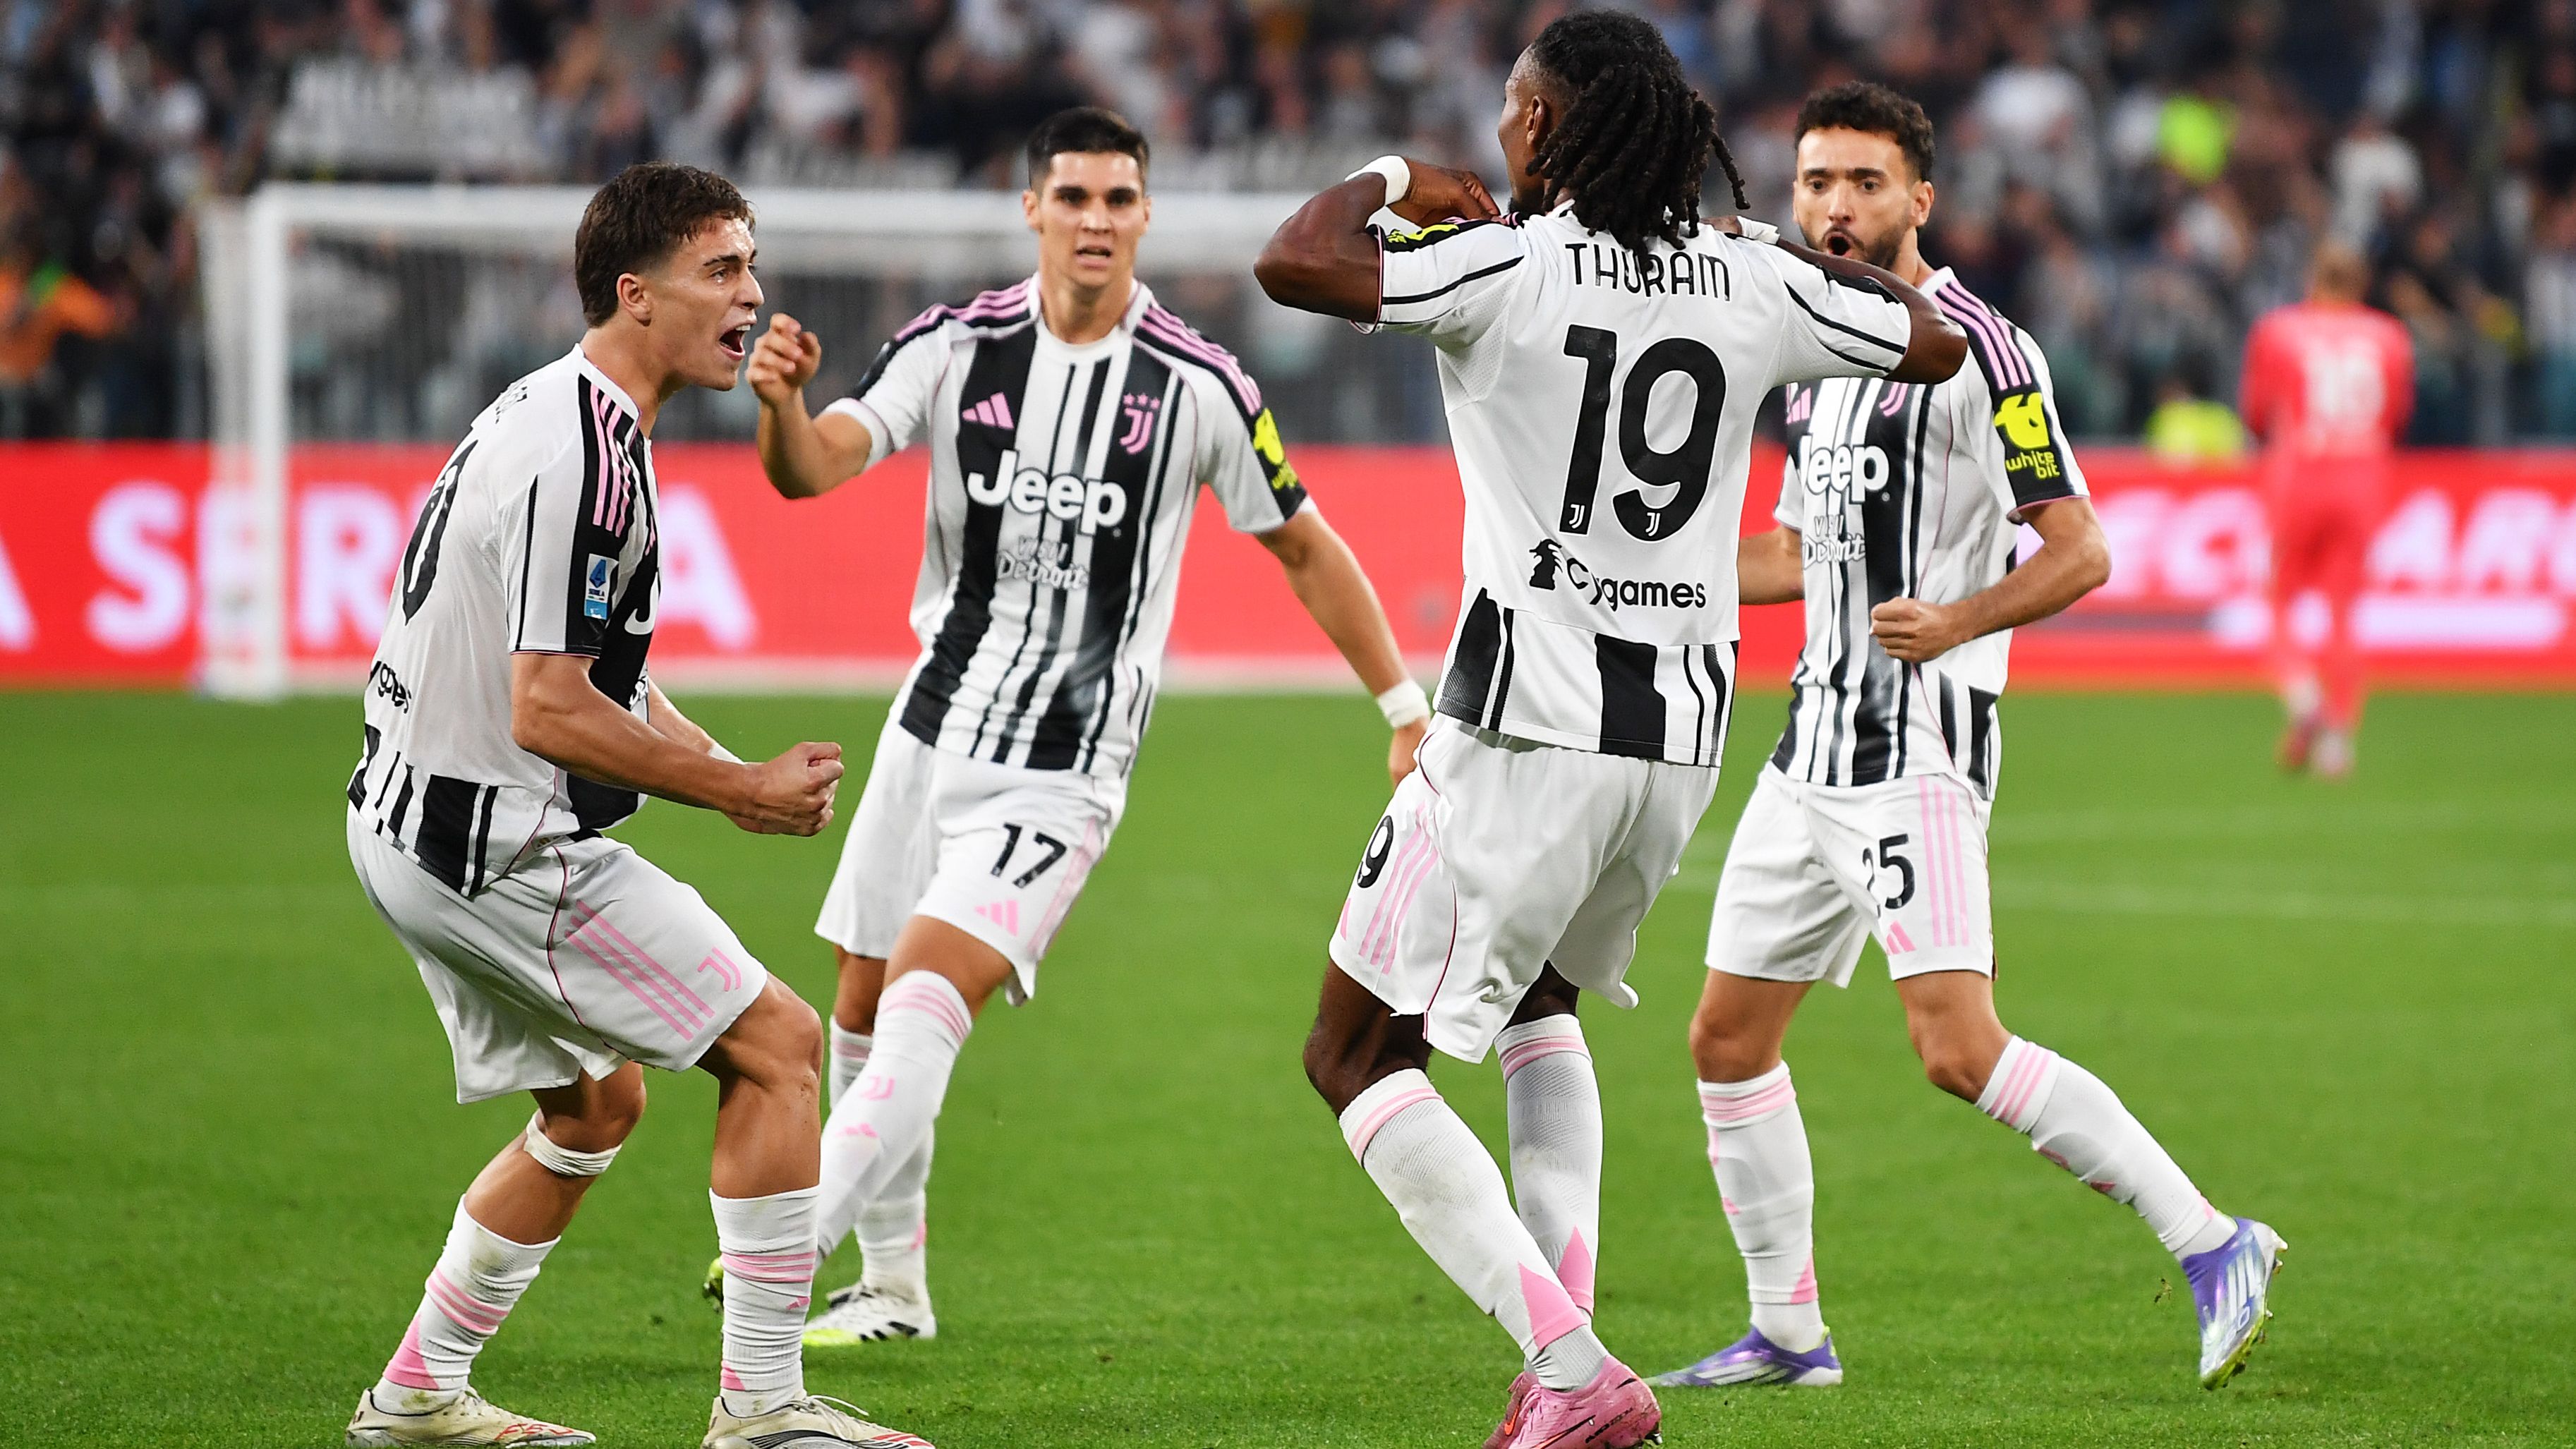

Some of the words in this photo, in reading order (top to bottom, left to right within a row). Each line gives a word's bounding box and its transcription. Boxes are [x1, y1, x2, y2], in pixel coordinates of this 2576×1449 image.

[1564, 243, 1731, 302] THURAM
[1560, 325, 1726, 542] 19
[967, 448, 1127, 535] Jeep
[990, 822, 1068, 889] 17
